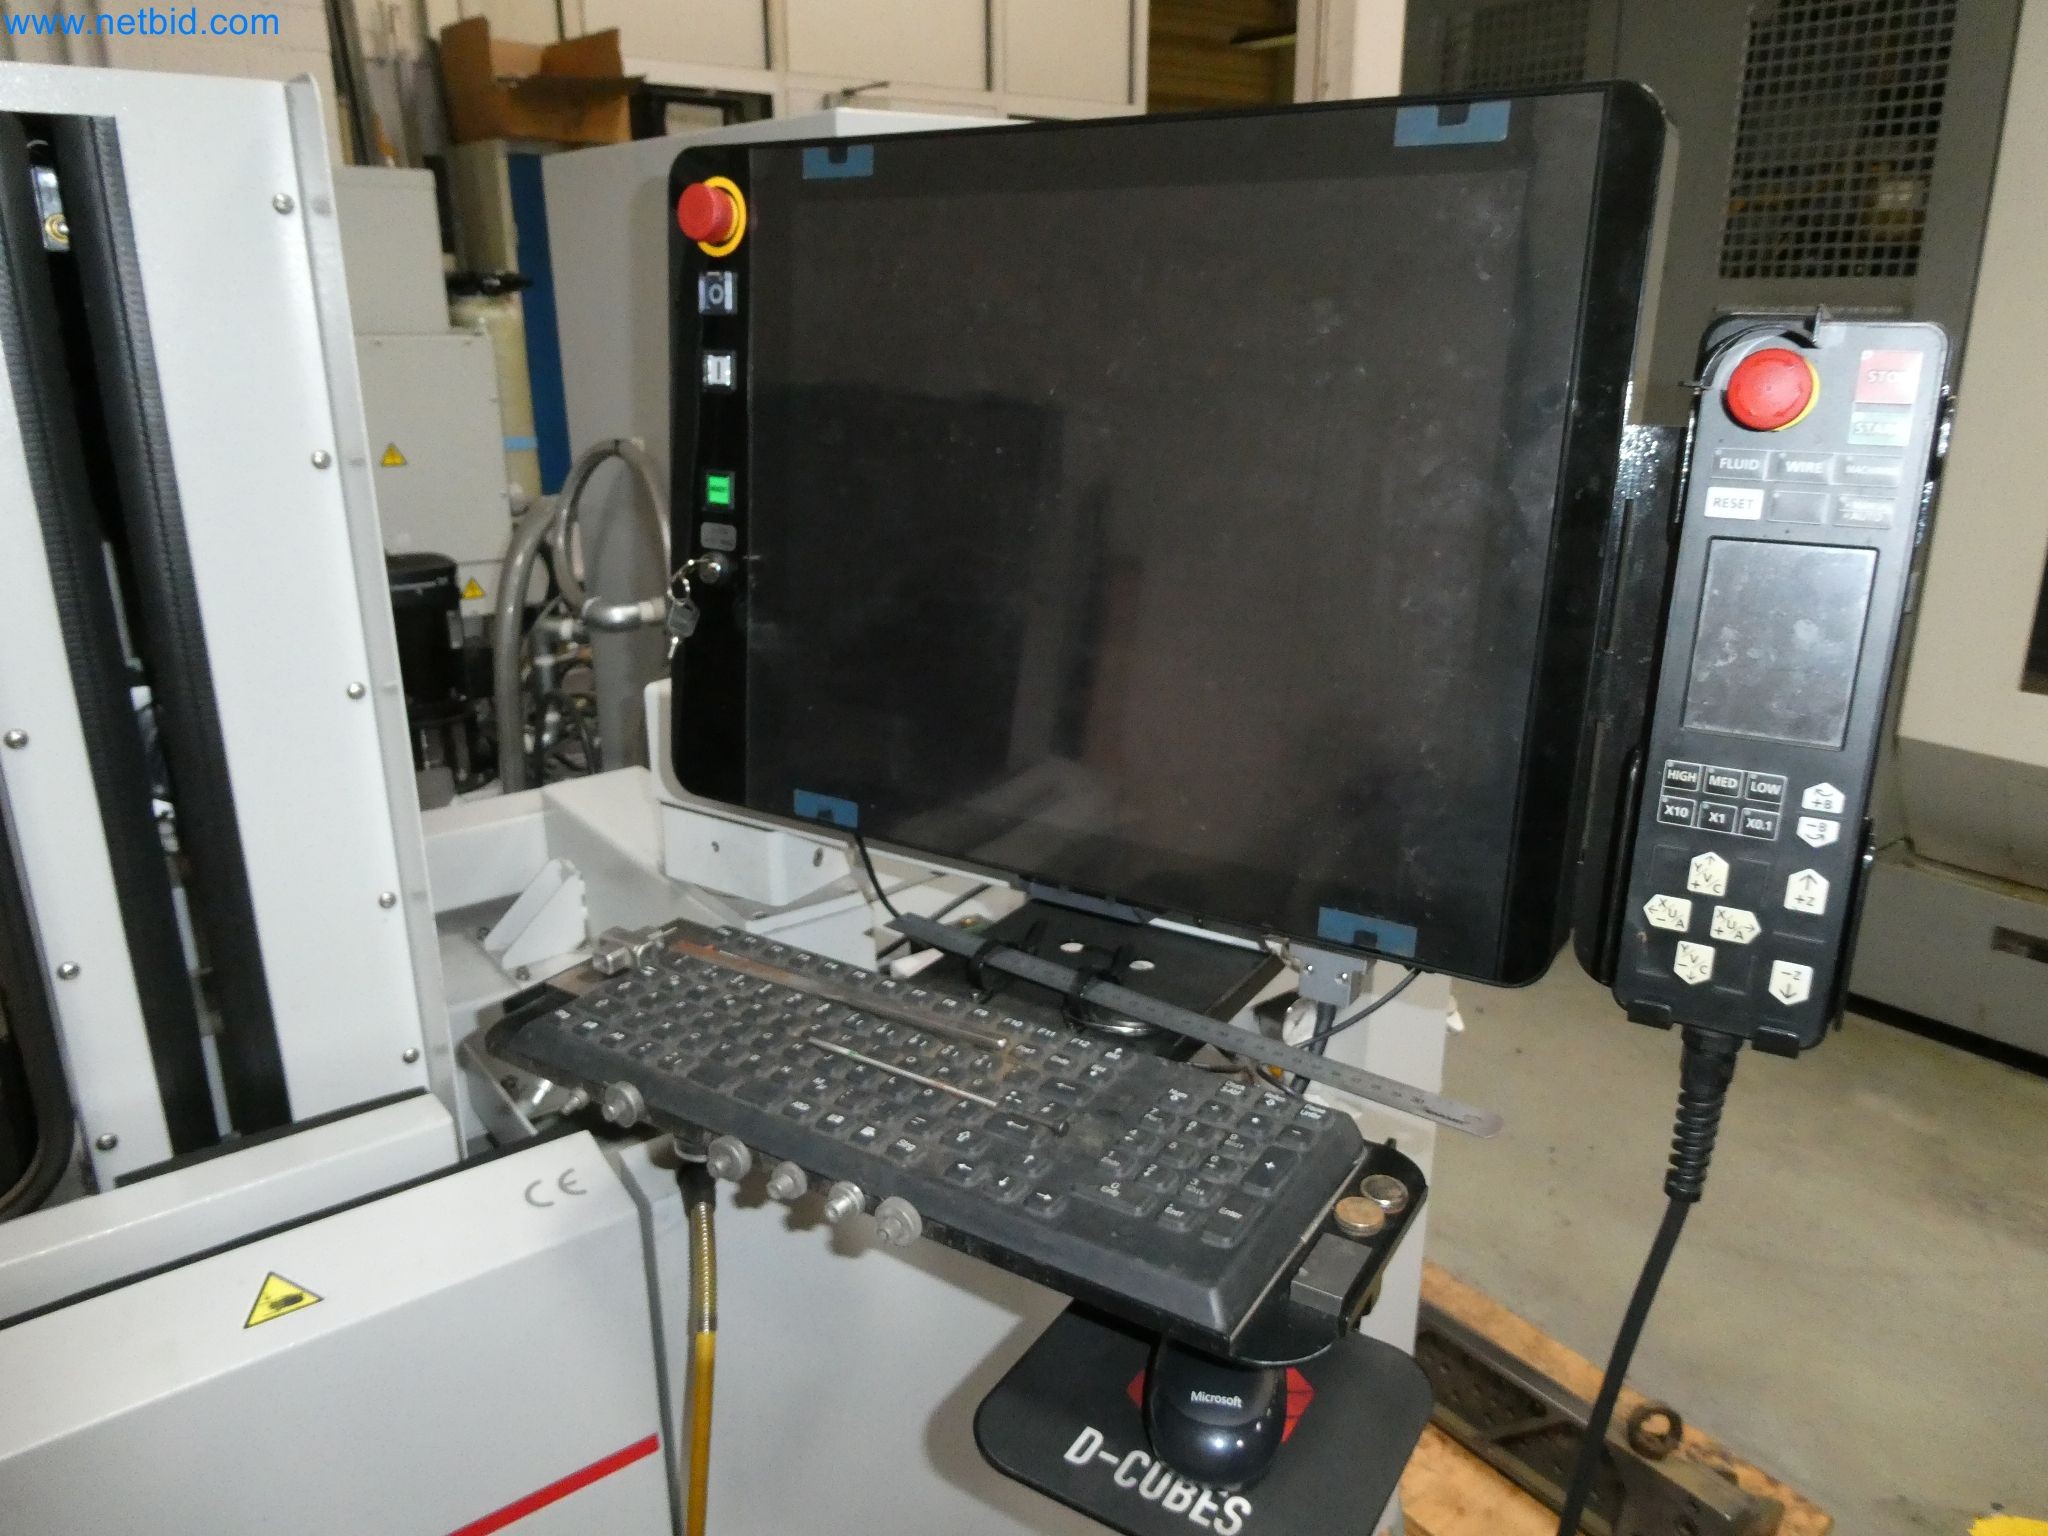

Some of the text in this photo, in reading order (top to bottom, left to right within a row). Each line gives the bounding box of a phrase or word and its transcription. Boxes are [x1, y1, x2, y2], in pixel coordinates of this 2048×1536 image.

[1867, 369, 1909, 385] STO
[1719, 457, 1760, 470] FLUID
[1785, 460, 1824, 474] WIRE
[1713, 496, 1754, 509] RESET
[1667, 769, 1698, 783] HIGH
[1709, 775, 1739, 788] MED
[1751, 781, 1781, 795] LOW
[1664, 804, 1689, 818] X10
[1708, 811, 1726, 824] X1
[1746, 817, 1773, 832] X0.1
[524, 1168, 587, 1208] CE
[1190, 1390, 1243, 1408] Microsoft
[1063, 1425, 1253, 1536] D-CUBES
